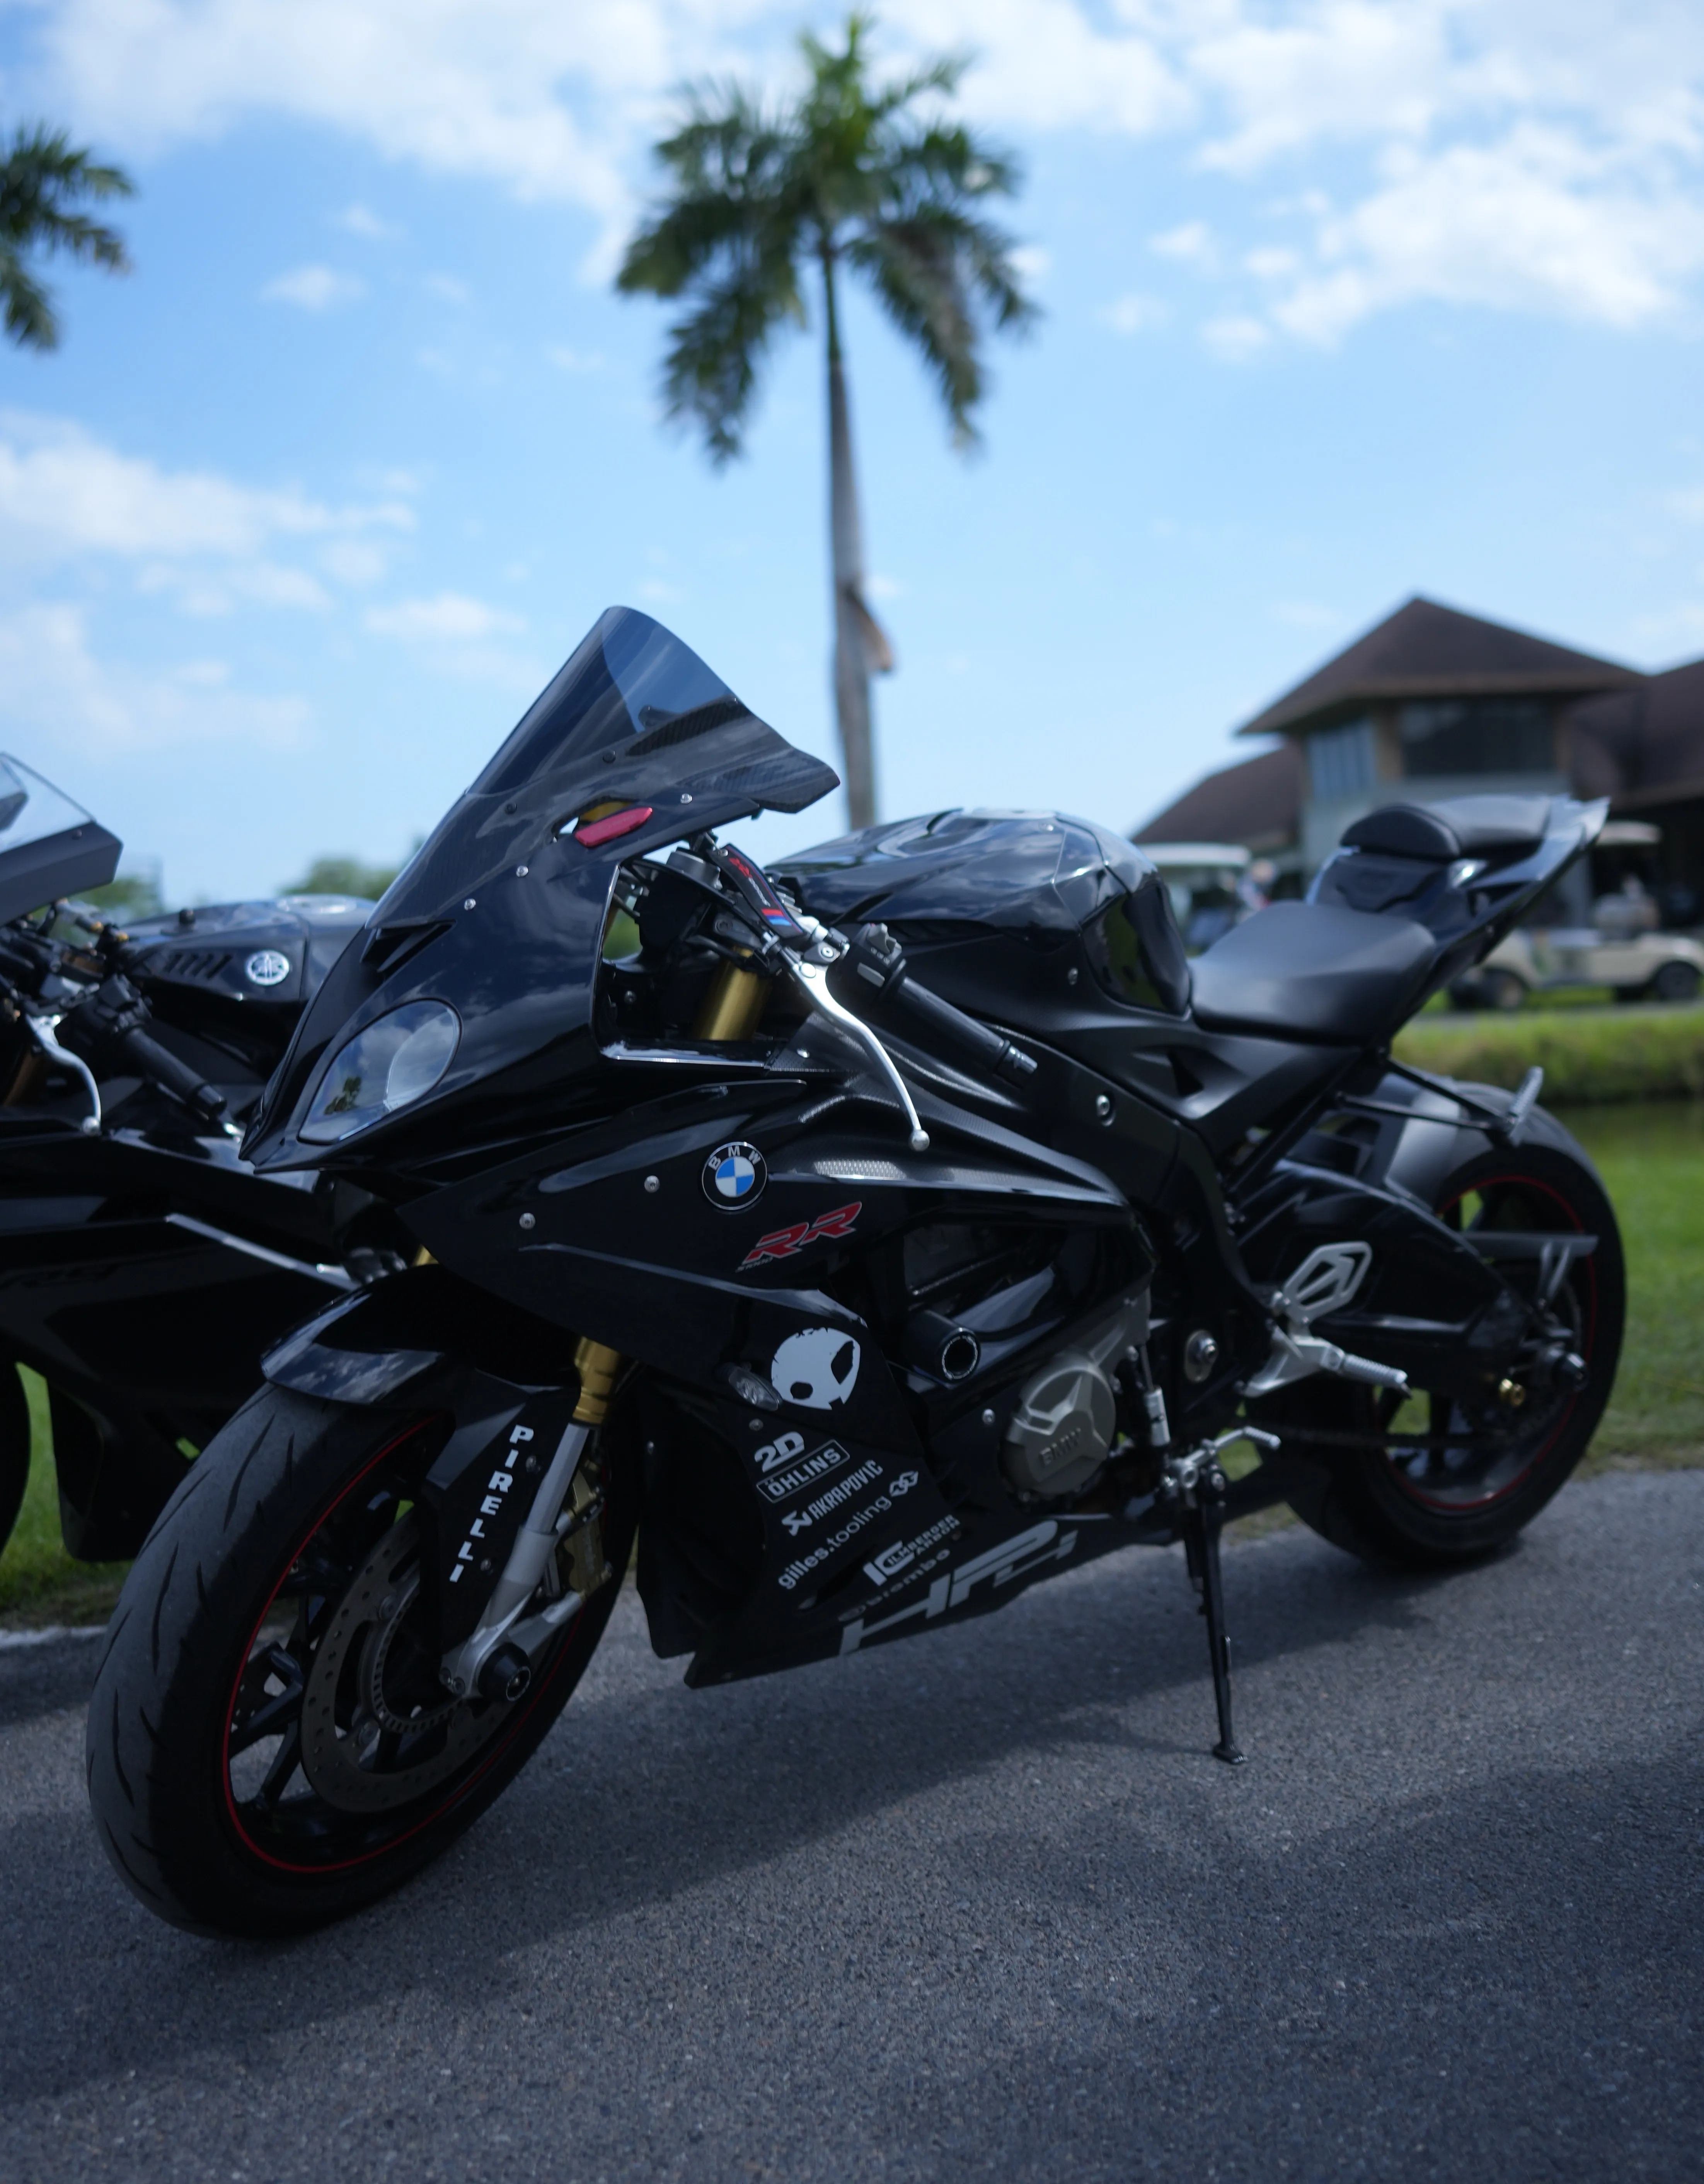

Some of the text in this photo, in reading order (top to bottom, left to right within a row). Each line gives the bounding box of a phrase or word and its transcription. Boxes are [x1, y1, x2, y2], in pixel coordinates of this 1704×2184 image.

[709, 1146, 761, 1170] BMW
[742, 1201, 862, 1265] RR
[754, 1431, 805, 1473] 2D
[1038, 1427, 1082, 1468] BMW
[765, 1448, 841, 1497] ÖHLINS
[449, 1424, 534, 1582] PIRELLI
[778, 1495, 892, 1590] gilles.tooling
